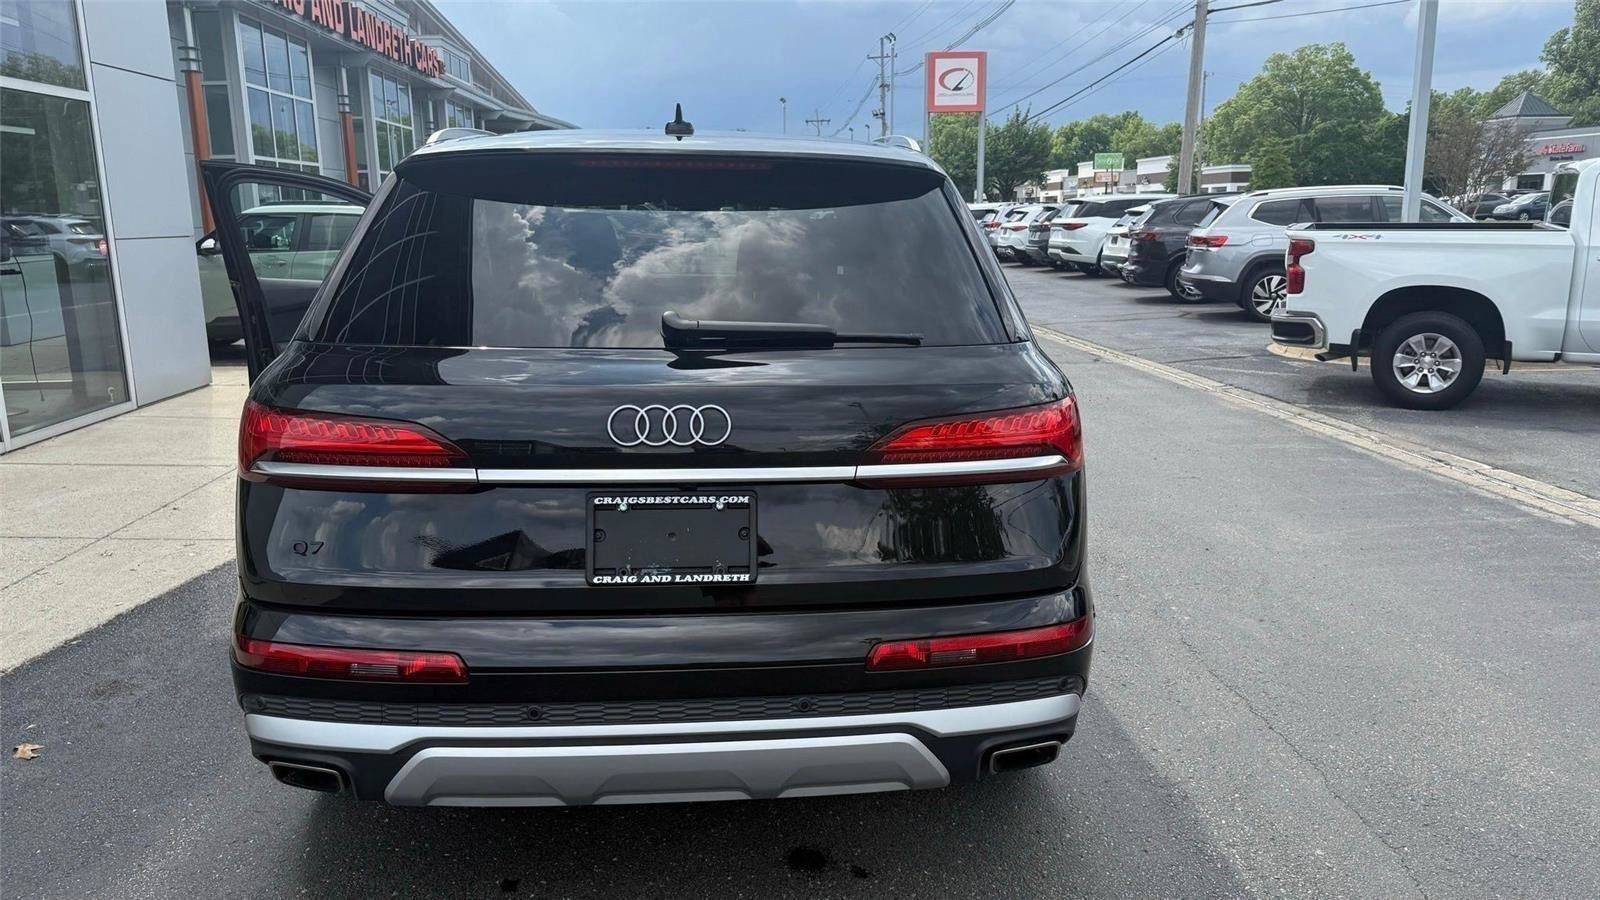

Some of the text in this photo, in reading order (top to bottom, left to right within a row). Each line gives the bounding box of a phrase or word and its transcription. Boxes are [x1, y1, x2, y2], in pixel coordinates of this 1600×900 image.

[311, 0, 345, 34] AND
[349, 2, 414, 67] LANDRETH
[414, 41, 440, 78] CARS
[594, 495, 750, 505] CRAIGSBESTCARS.COM
[293, 540, 324, 557] Q7
[593, 574, 750, 584] CRAIG AND LANDRETH
